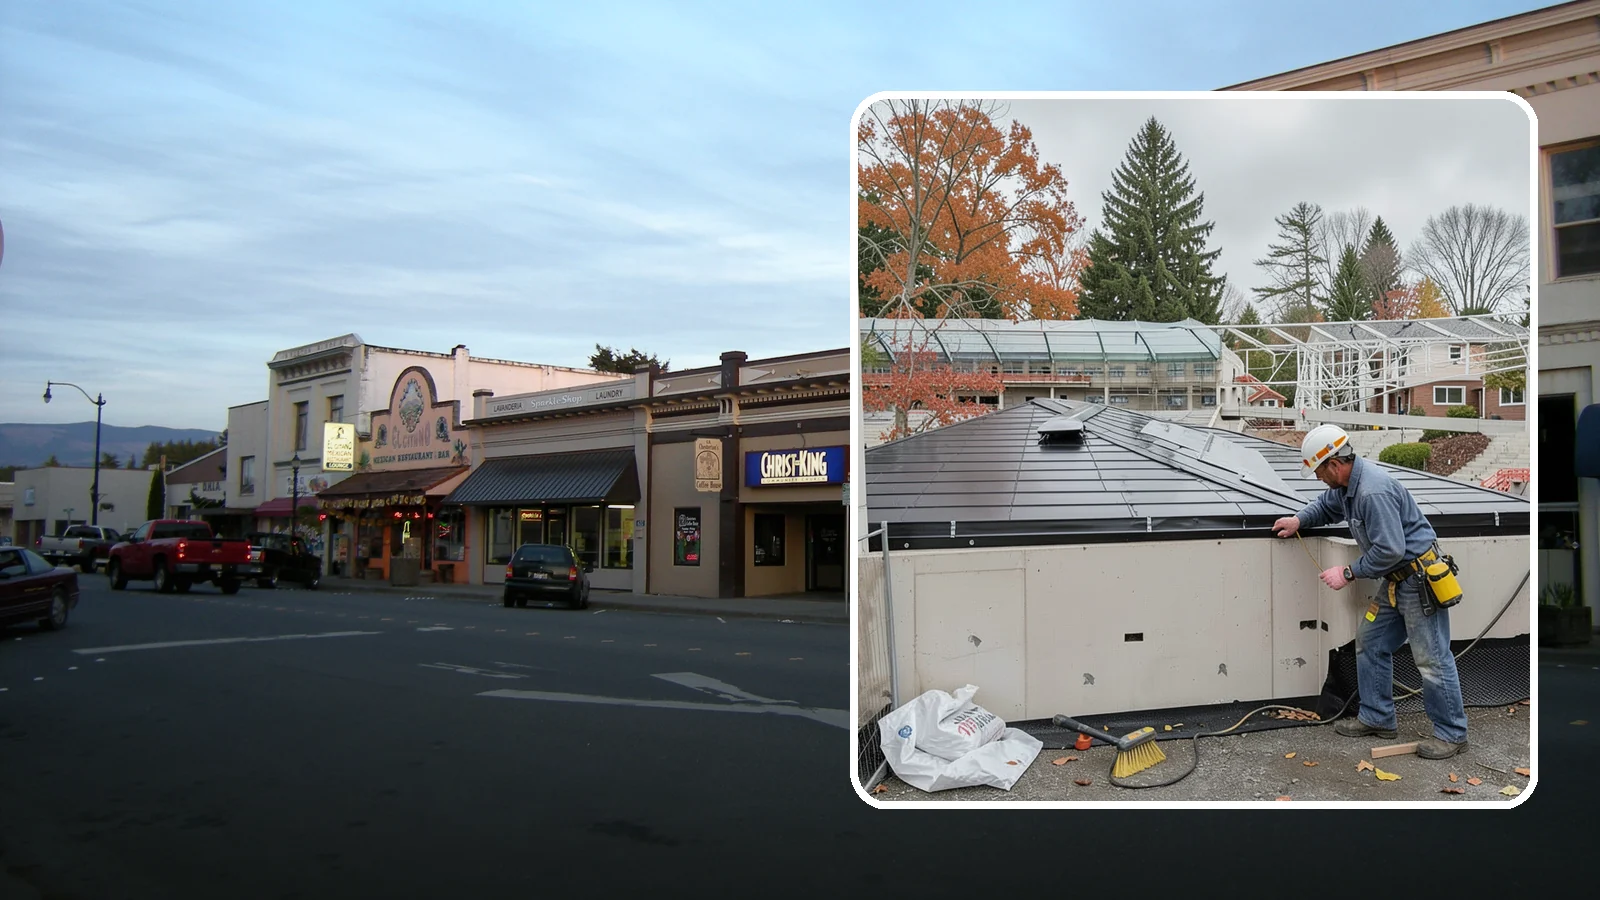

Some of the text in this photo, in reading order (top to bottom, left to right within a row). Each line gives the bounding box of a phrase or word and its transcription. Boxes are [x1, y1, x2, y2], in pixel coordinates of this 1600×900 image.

[493, 402, 522, 412] LAVANDERIA
[561, 394, 582, 405] Shop
[595, 389, 623, 400] LAUNDRY
[391, 425, 402, 449] EL
[373, 455, 396, 464] MEXICAN
[397, 451, 433, 462] RESTAURANT
[438, 450, 449, 459] BAR
[761, 450, 827, 478] CHRIST KING
